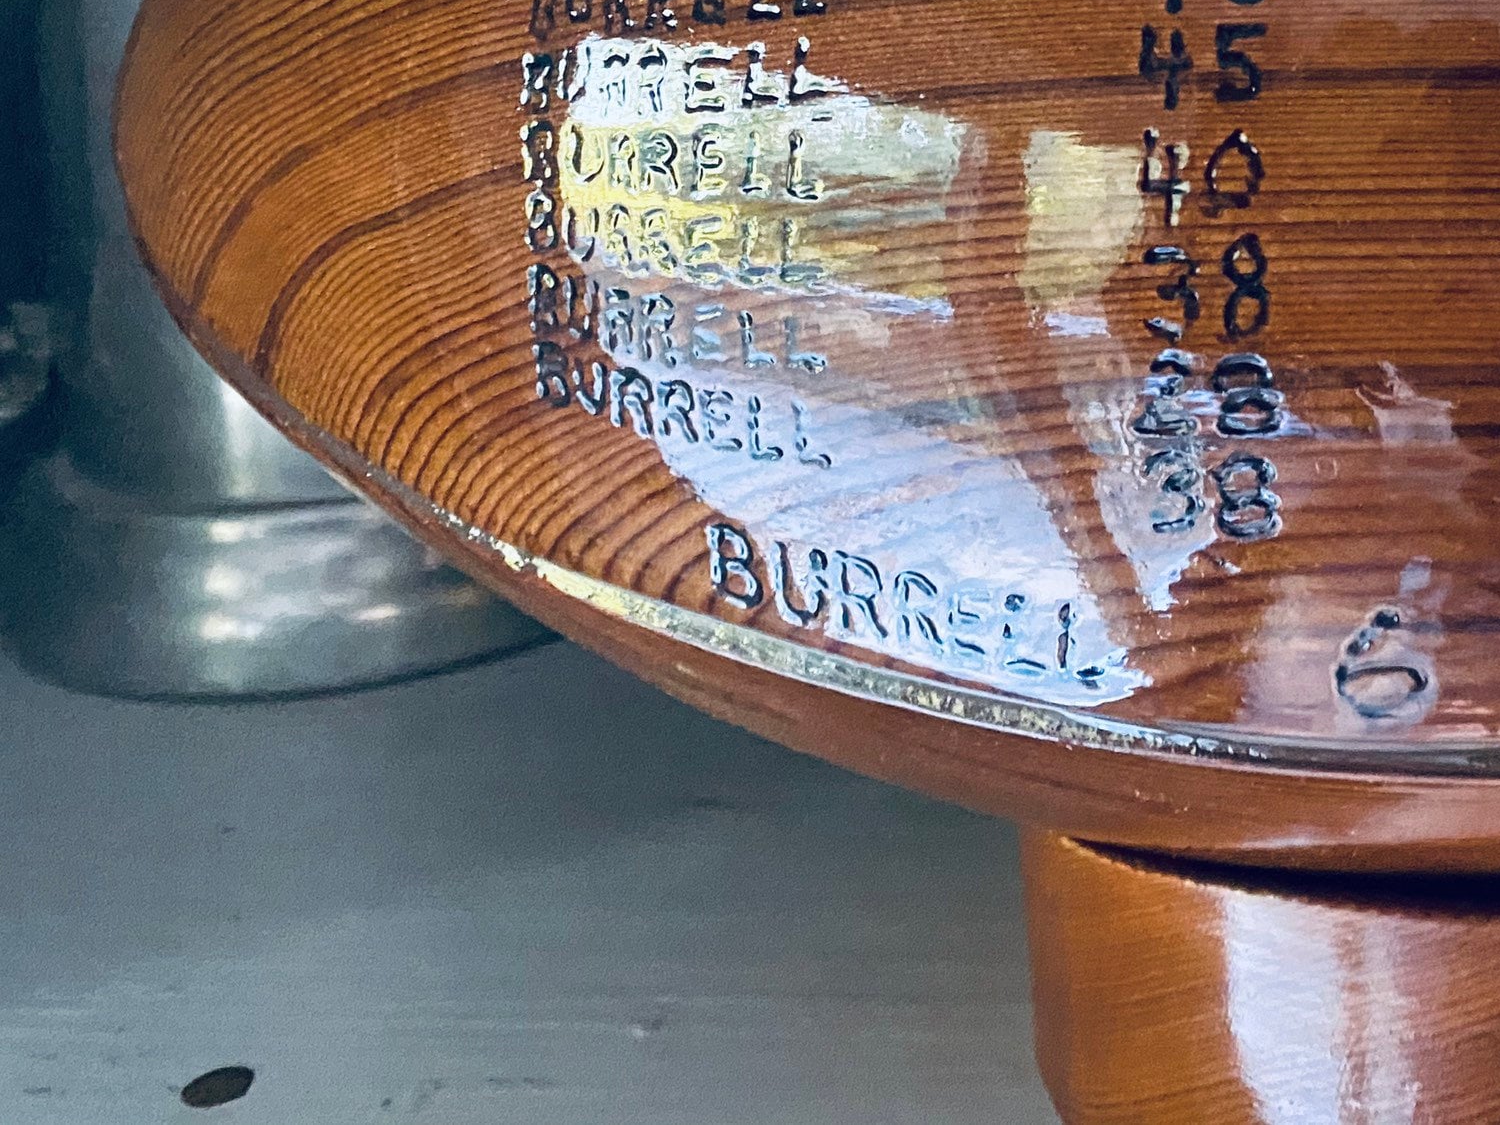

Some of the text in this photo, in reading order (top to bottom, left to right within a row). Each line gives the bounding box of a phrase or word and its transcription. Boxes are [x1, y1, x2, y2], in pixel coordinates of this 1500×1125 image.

[520, 35, 838, 115] BURRELL
[1139, 21, 1270, 112] 45
[520, 119, 827, 202] BURRELL
[1137, 127, 1267, 229] 40
[524, 187, 826, 285] BURRELL
[527, 263, 828, 375] BURRELL
[532, 341, 832, 468] BURRELL
[706, 522, 1110, 690] BURRELL
